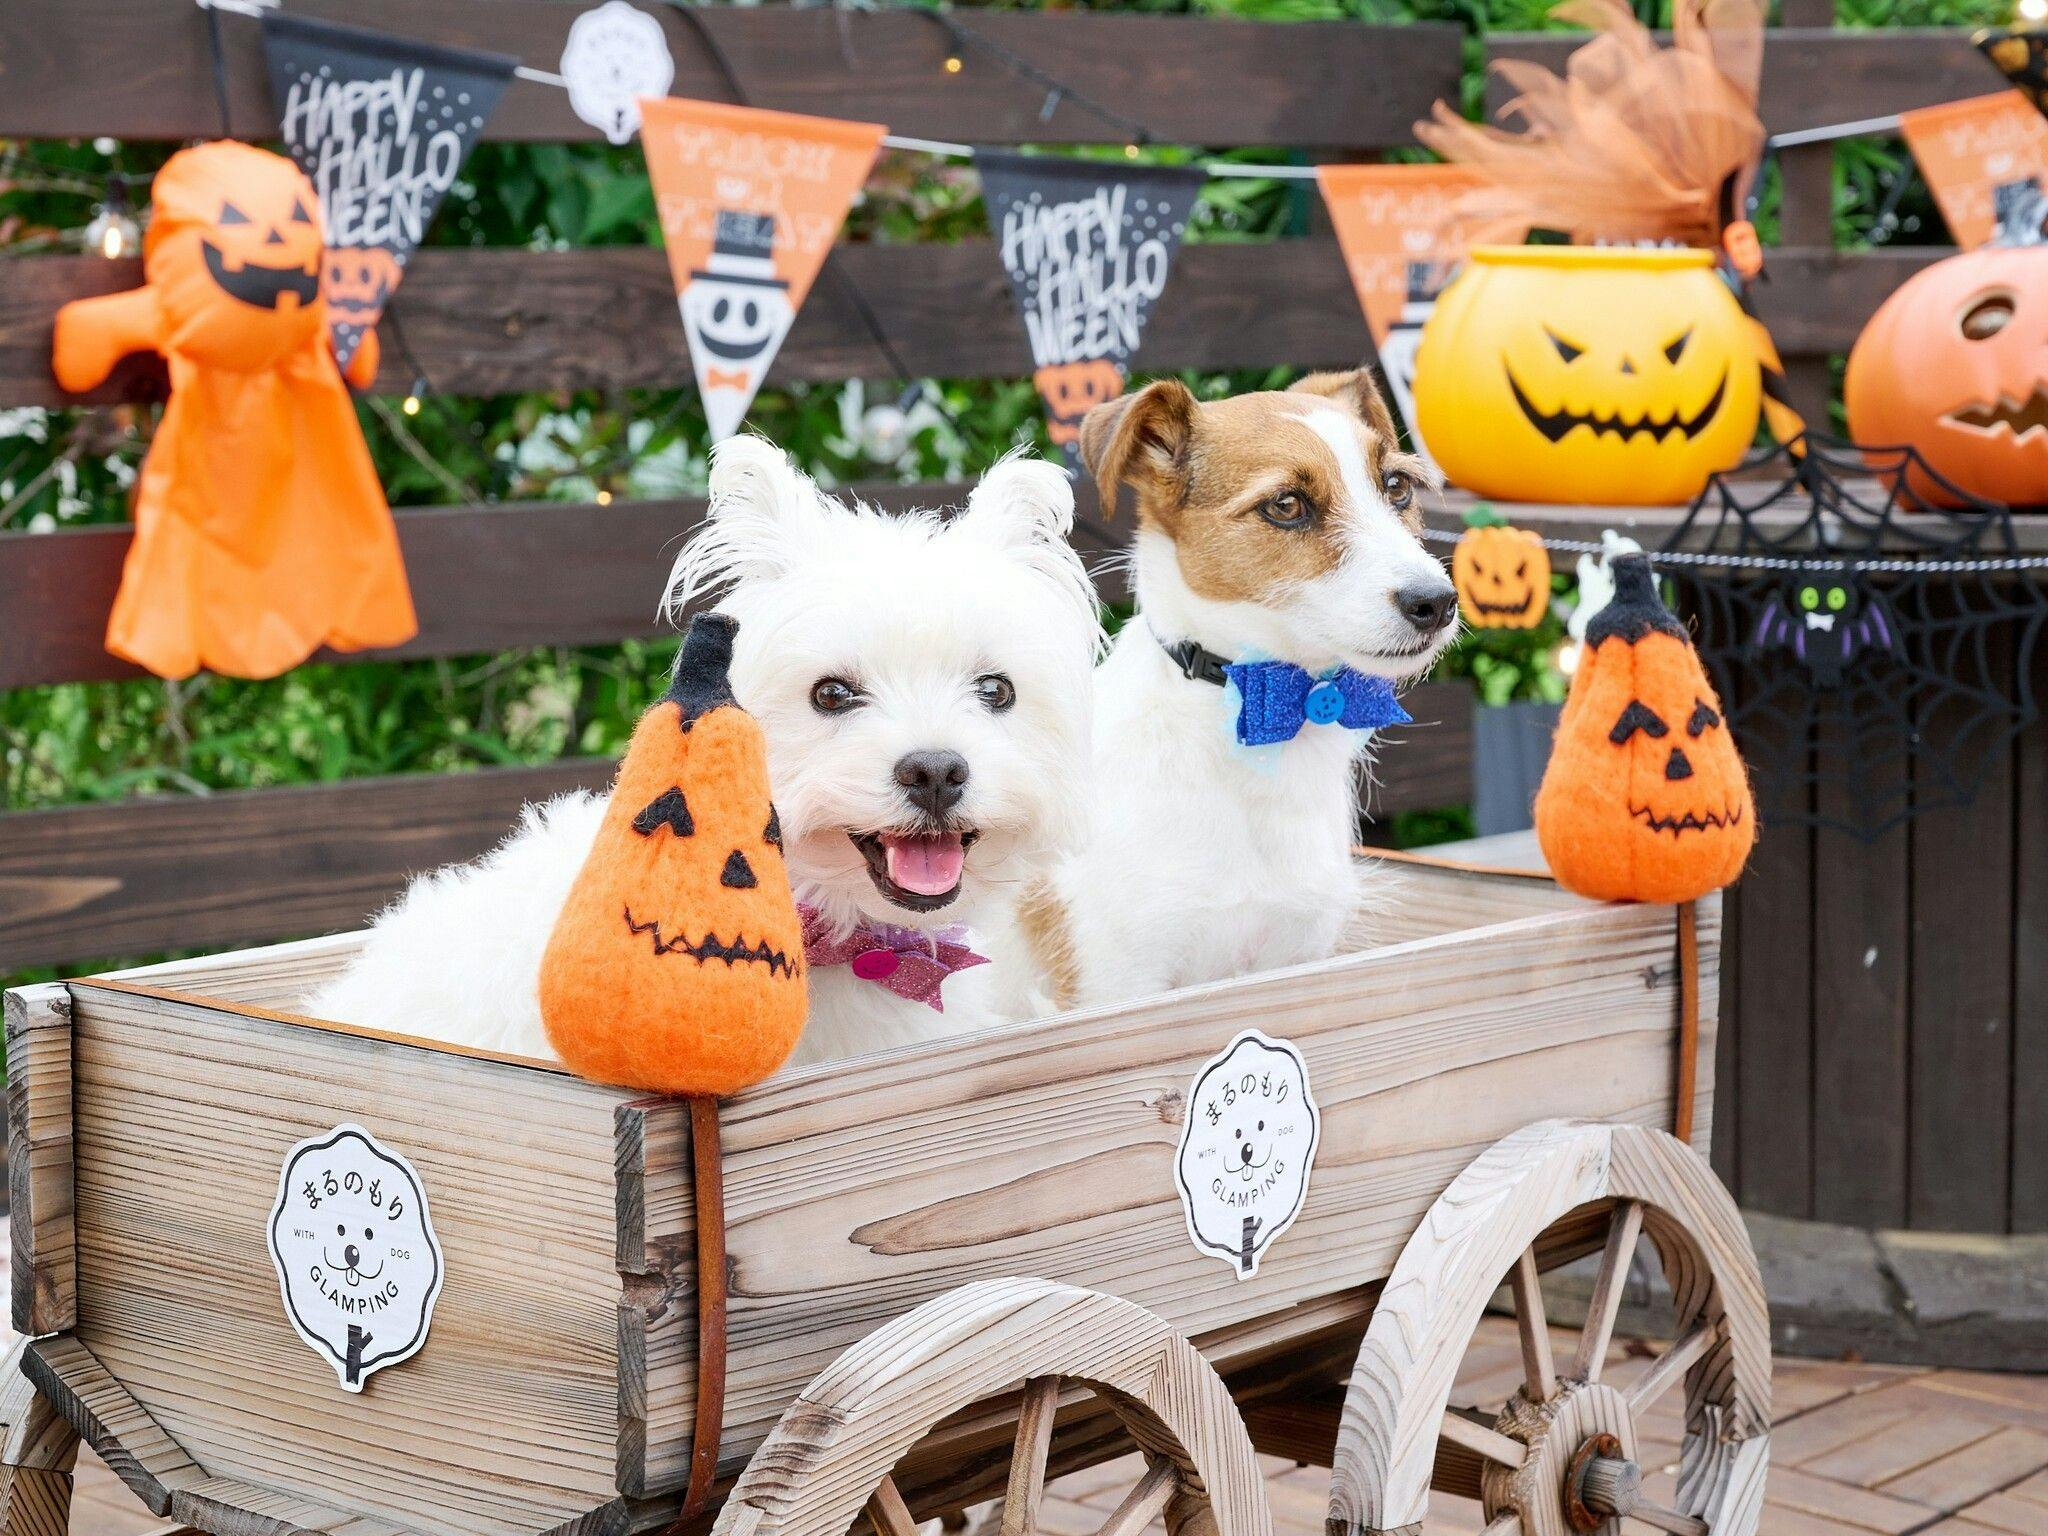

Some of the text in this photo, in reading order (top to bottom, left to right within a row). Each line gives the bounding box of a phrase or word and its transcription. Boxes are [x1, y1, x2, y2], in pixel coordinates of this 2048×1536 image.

[282, 67, 424, 149] HAPPY
[316, 130, 461, 198] HALLO
[1003, 183, 1127, 275] HAPPY
[1037, 238, 1168, 307] HALLO
[1024, 299, 1141, 367] WEEN
[1206, 1072, 1288, 1126] まるのもり
[1198, 1126, 1294, 1159] WITH DOG
[302, 1169, 403, 1221] まるのもり
[1212, 1159, 1285, 1208] GLAMPING
[293, 1228, 410, 1260] WITH DOG
[310, 1265, 399, 1315] GLAMPING
